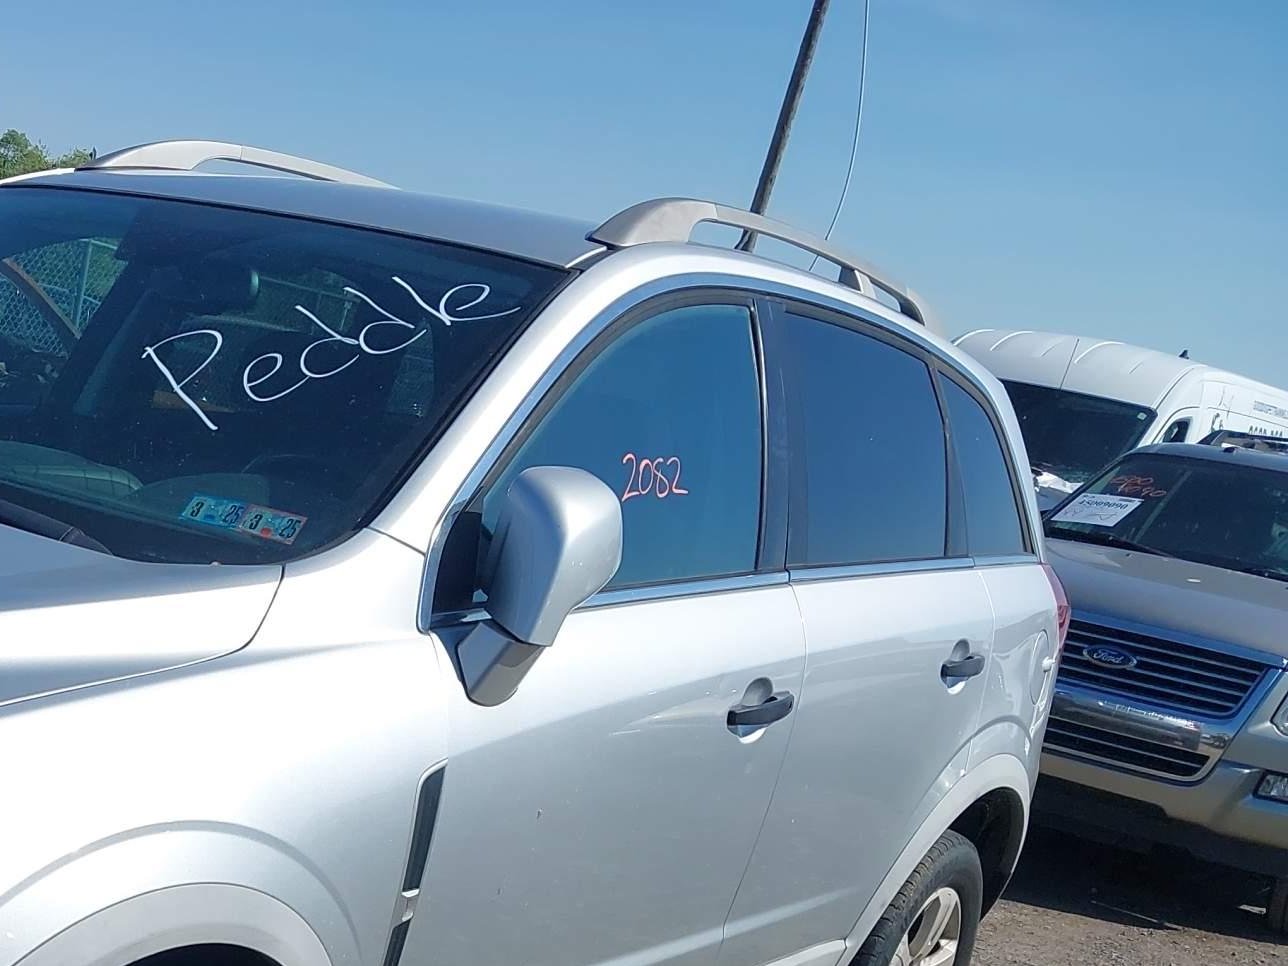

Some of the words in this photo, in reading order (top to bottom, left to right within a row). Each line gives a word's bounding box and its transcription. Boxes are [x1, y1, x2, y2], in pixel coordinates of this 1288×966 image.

[141, 276, 521, 431] Peddle
[621, 453, 689, 502] 2082
[222, 504, 244, 526] 25
[279, 518, 301, 539] 25
